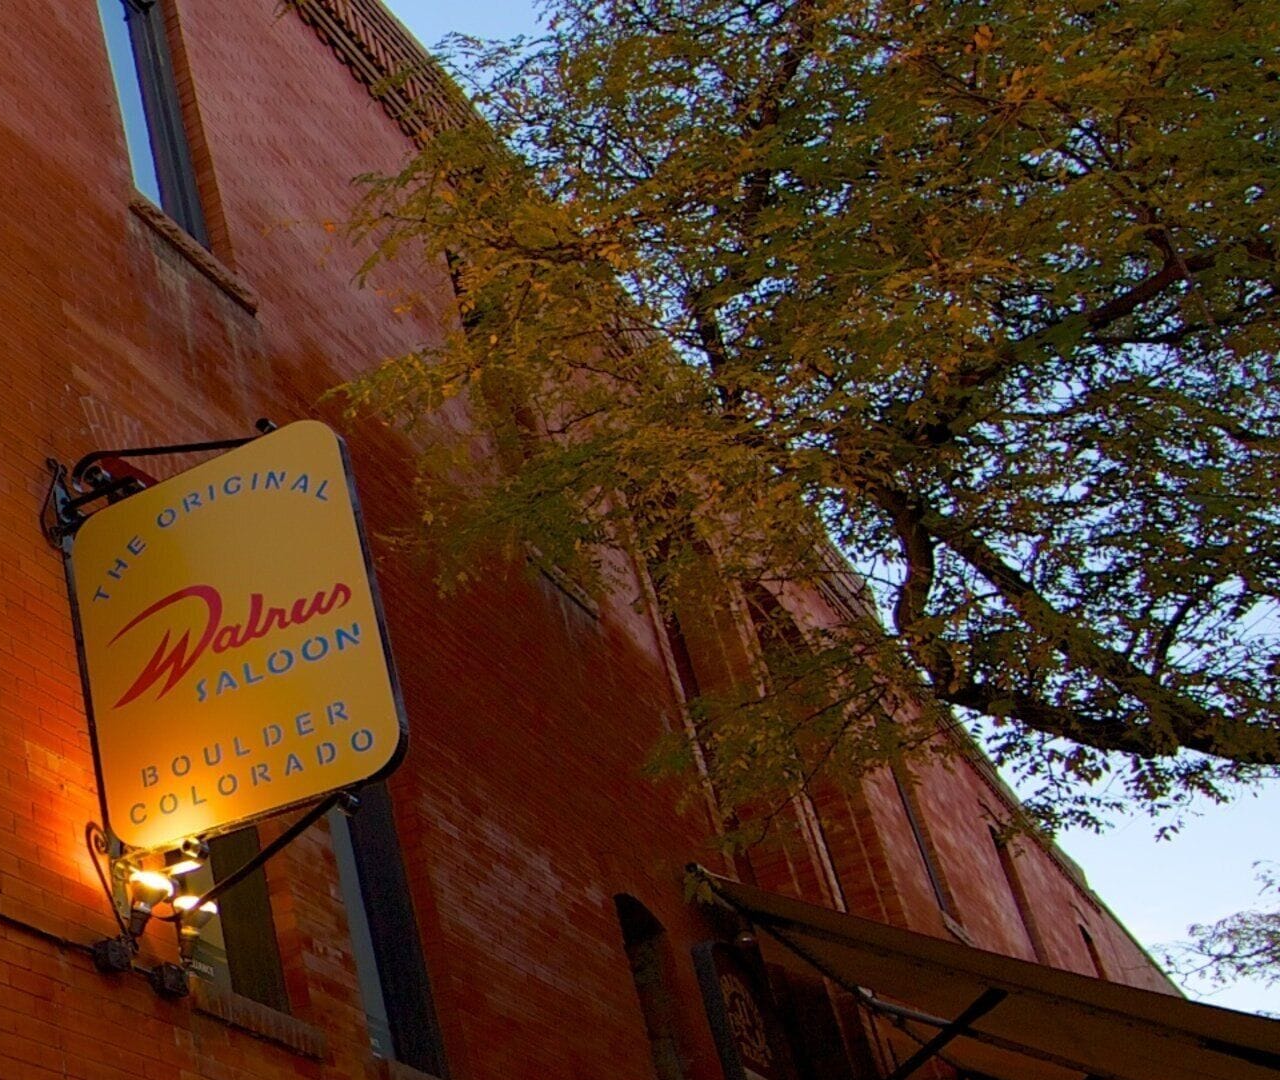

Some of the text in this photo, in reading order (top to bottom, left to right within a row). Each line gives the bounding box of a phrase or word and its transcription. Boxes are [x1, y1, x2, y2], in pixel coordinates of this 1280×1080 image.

[93, 471, 330, 602] THE ORIGINAL
[107, 583, 352, 709] Walrus
[196, 622, 361, 702] SALOON
[129, 728, 374, 825] COLORADO
[142, 701, 348, 788] BOULDER
